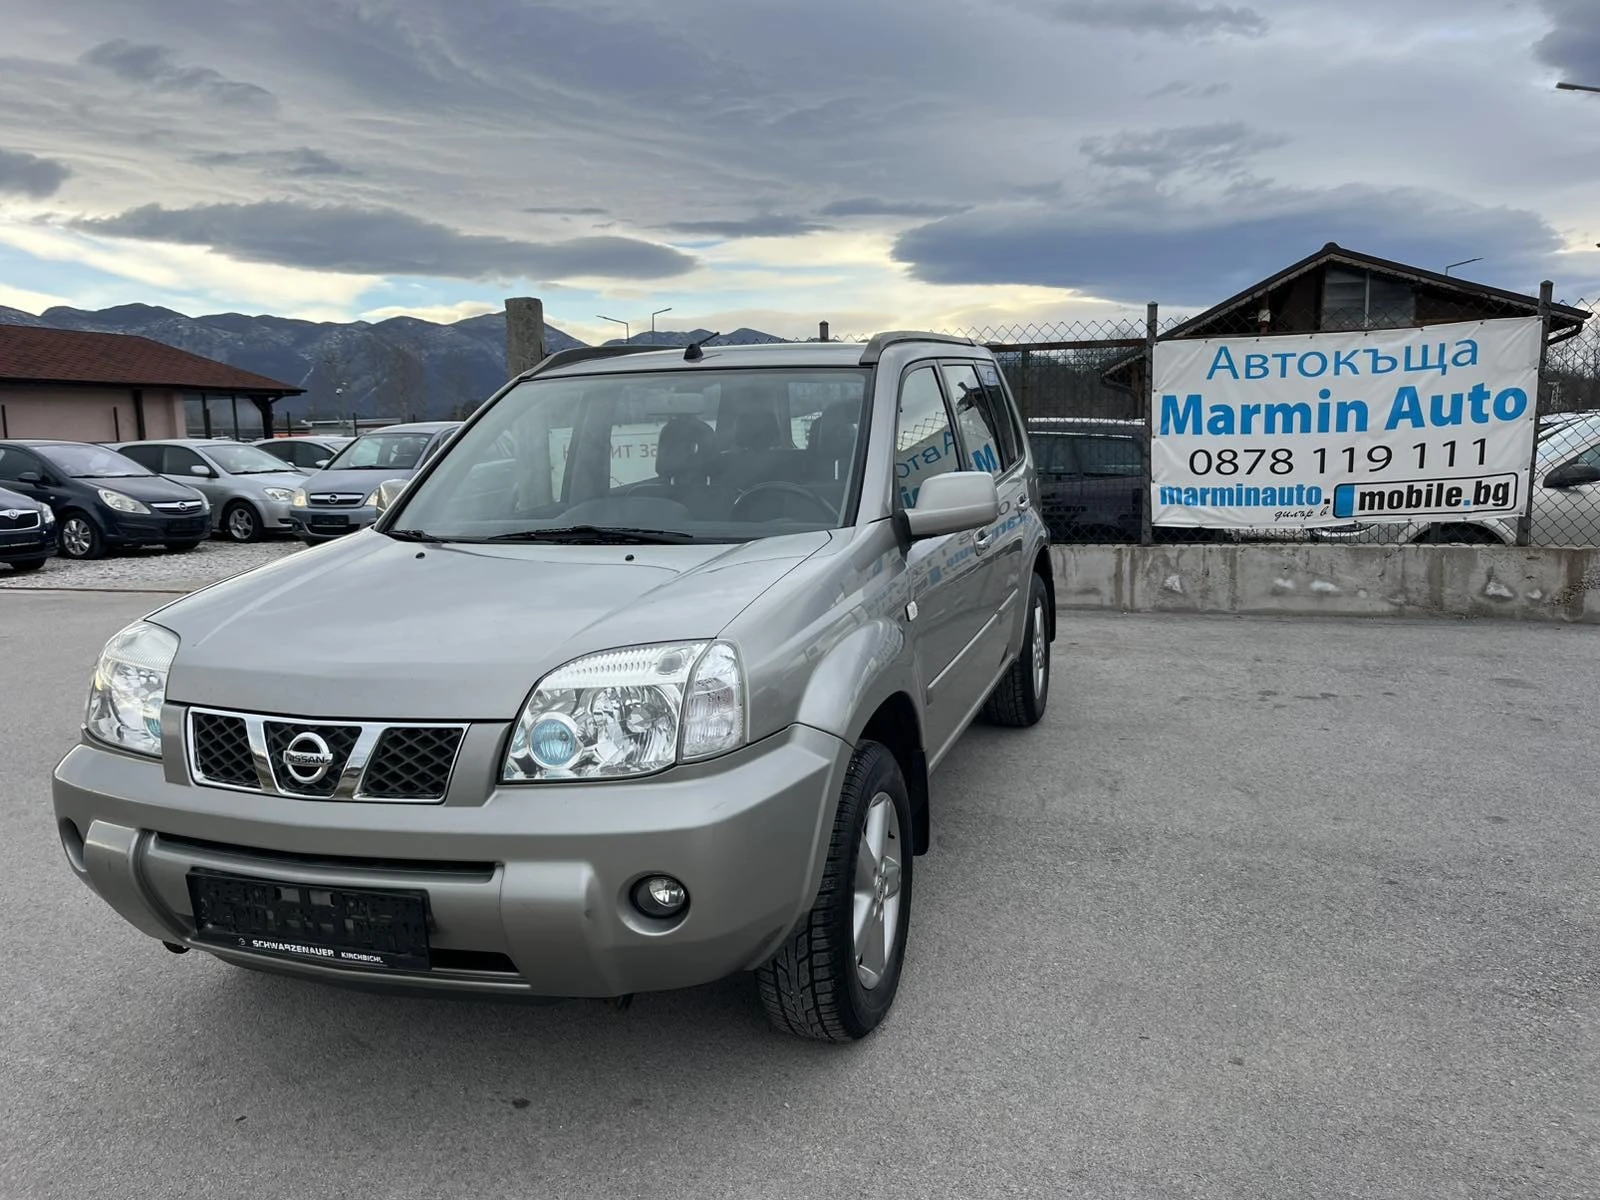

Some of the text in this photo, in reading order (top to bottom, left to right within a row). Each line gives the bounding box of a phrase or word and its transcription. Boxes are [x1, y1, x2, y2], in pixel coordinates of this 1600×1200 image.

[1207, 338, 1479, 380] Автокъща
[1160, 382, 1528, 436] Marmin Auto
[1188, 438, 1488, 476] 0878 119 111
[1159, 479, 1511, 512] marminauto. mobile.bg
[285, 751, 325, 763] NISSAN
[252, 939, 334, 956] SCHWARZENAUER
